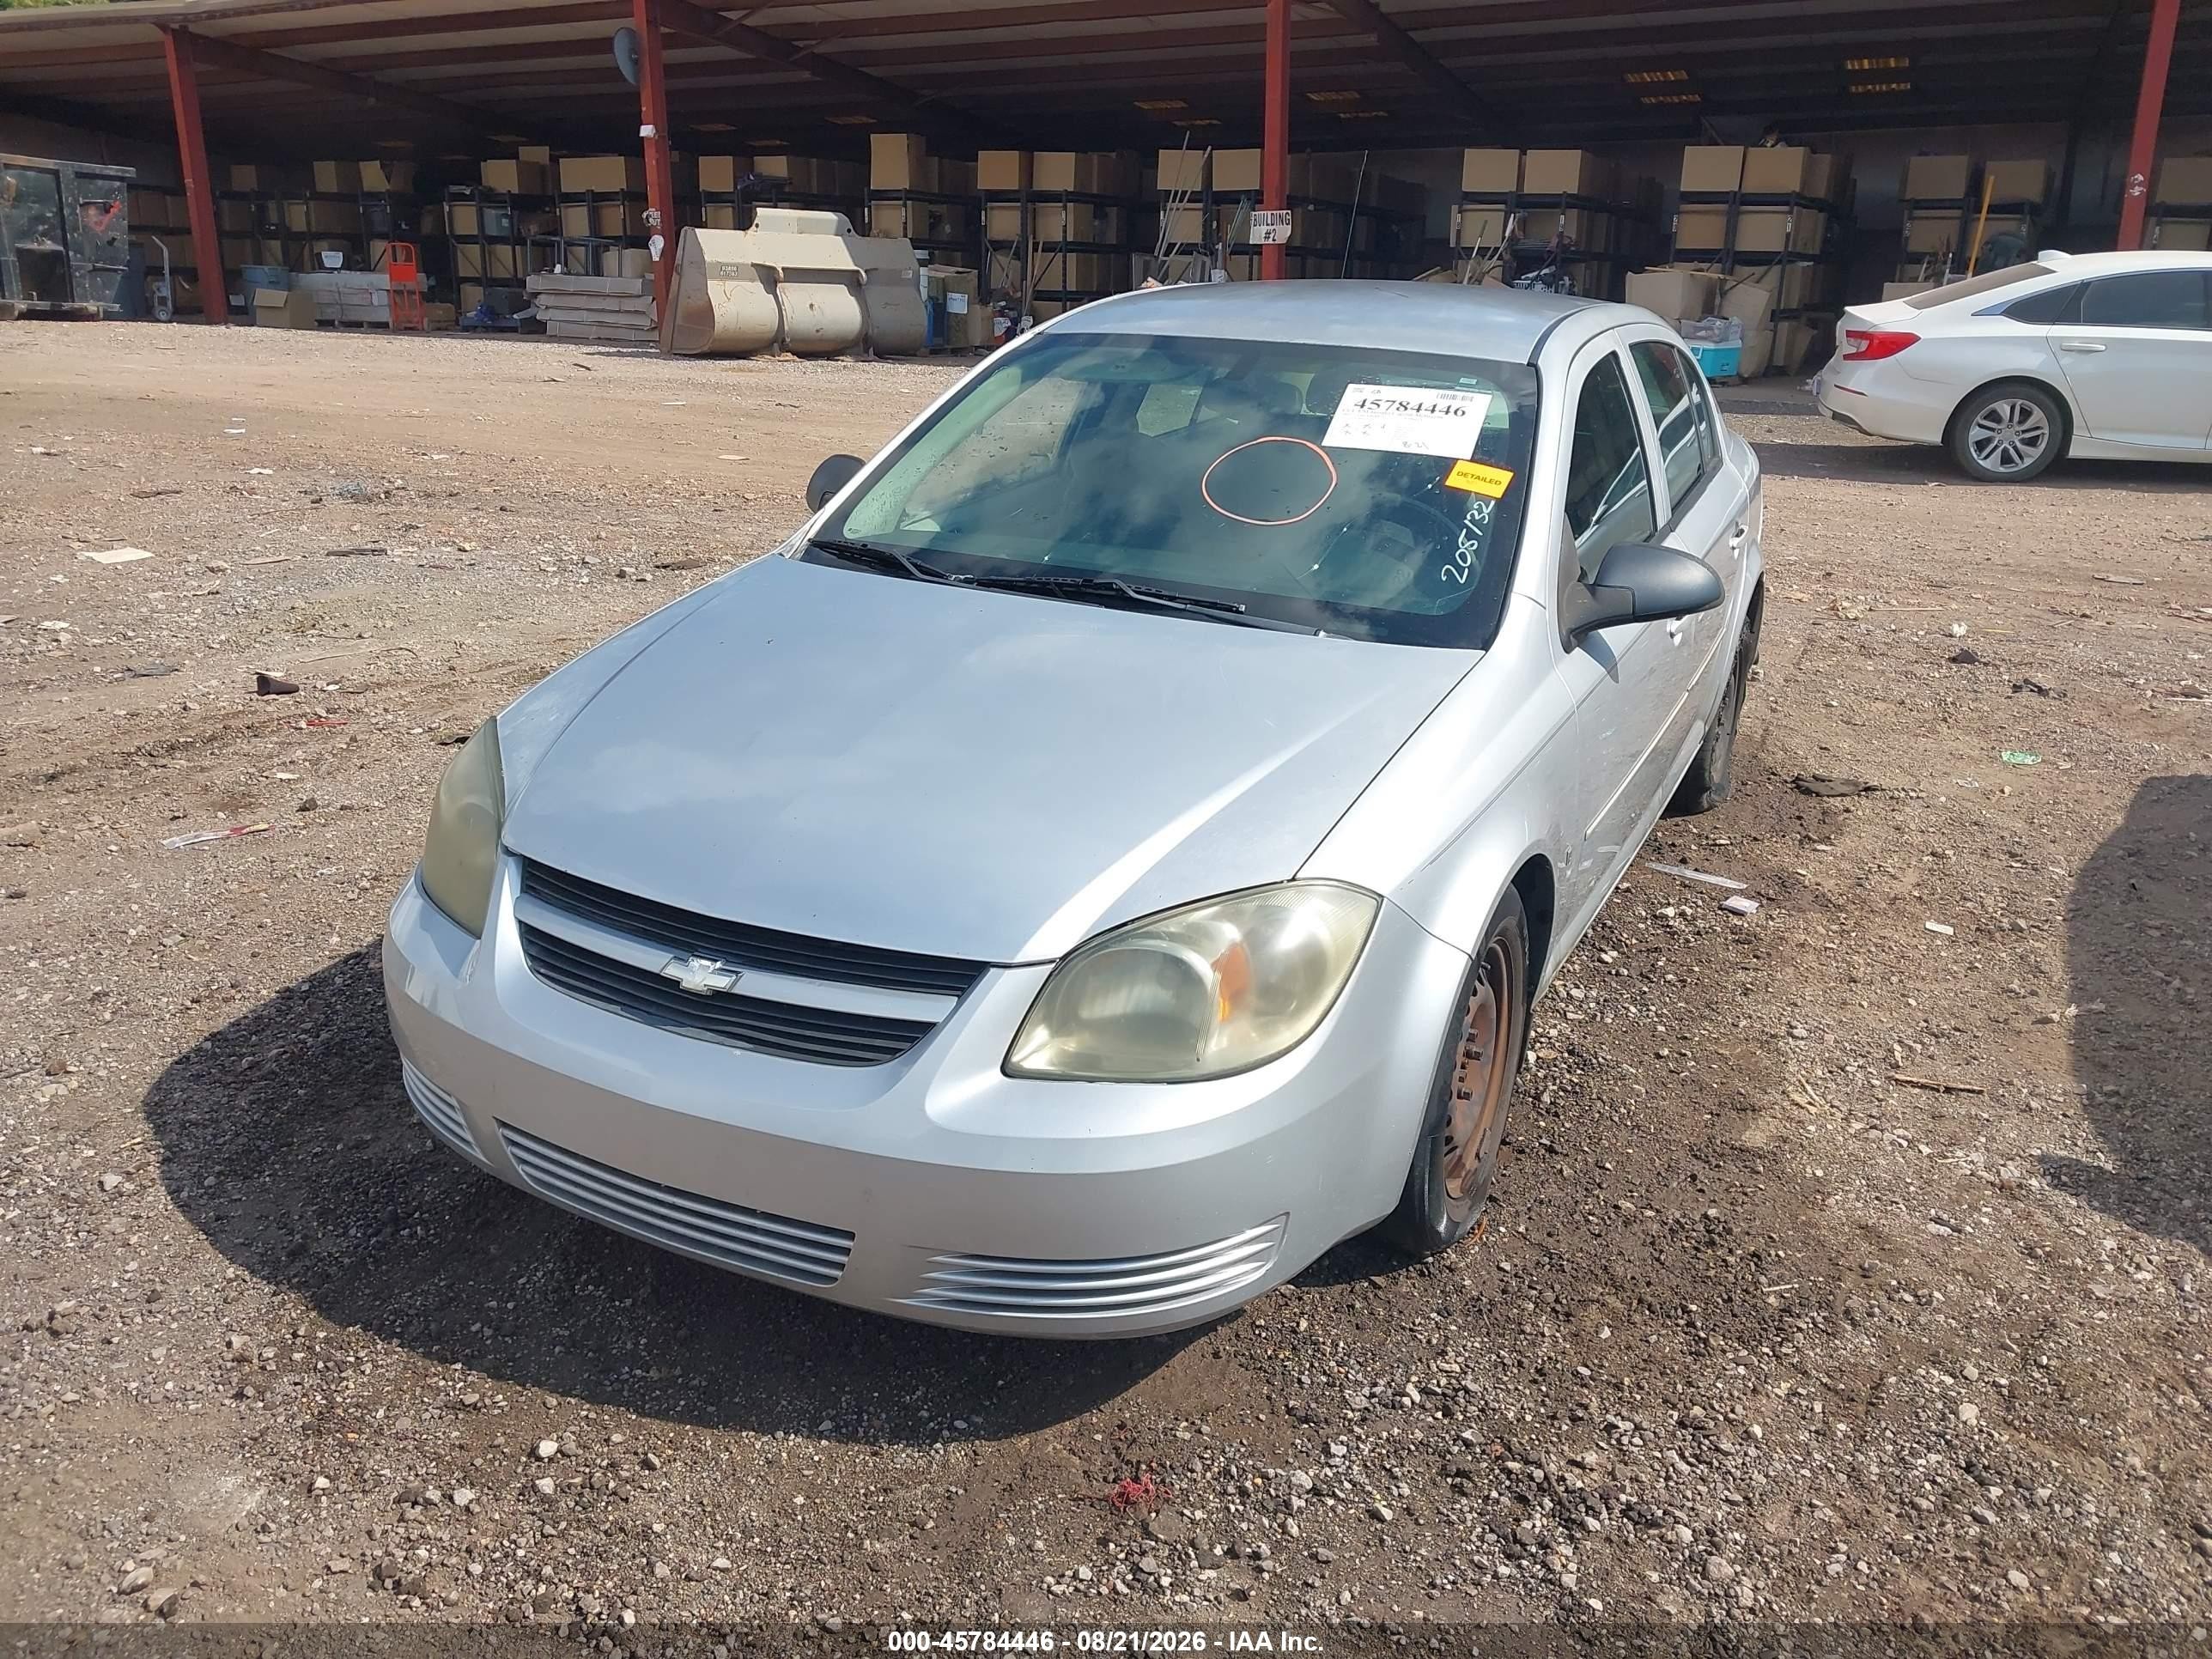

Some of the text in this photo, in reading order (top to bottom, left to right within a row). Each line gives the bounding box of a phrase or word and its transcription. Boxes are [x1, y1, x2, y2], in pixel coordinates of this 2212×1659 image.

[1254, 212, 1291, 227] BUILDING
[1263, 228, 1277, 241] #2
[1353, 398, 1467, 417] 45784446
[1455, 471, 1502, 486] DETAILED
[1441, 500, 1496, 584] 205132
